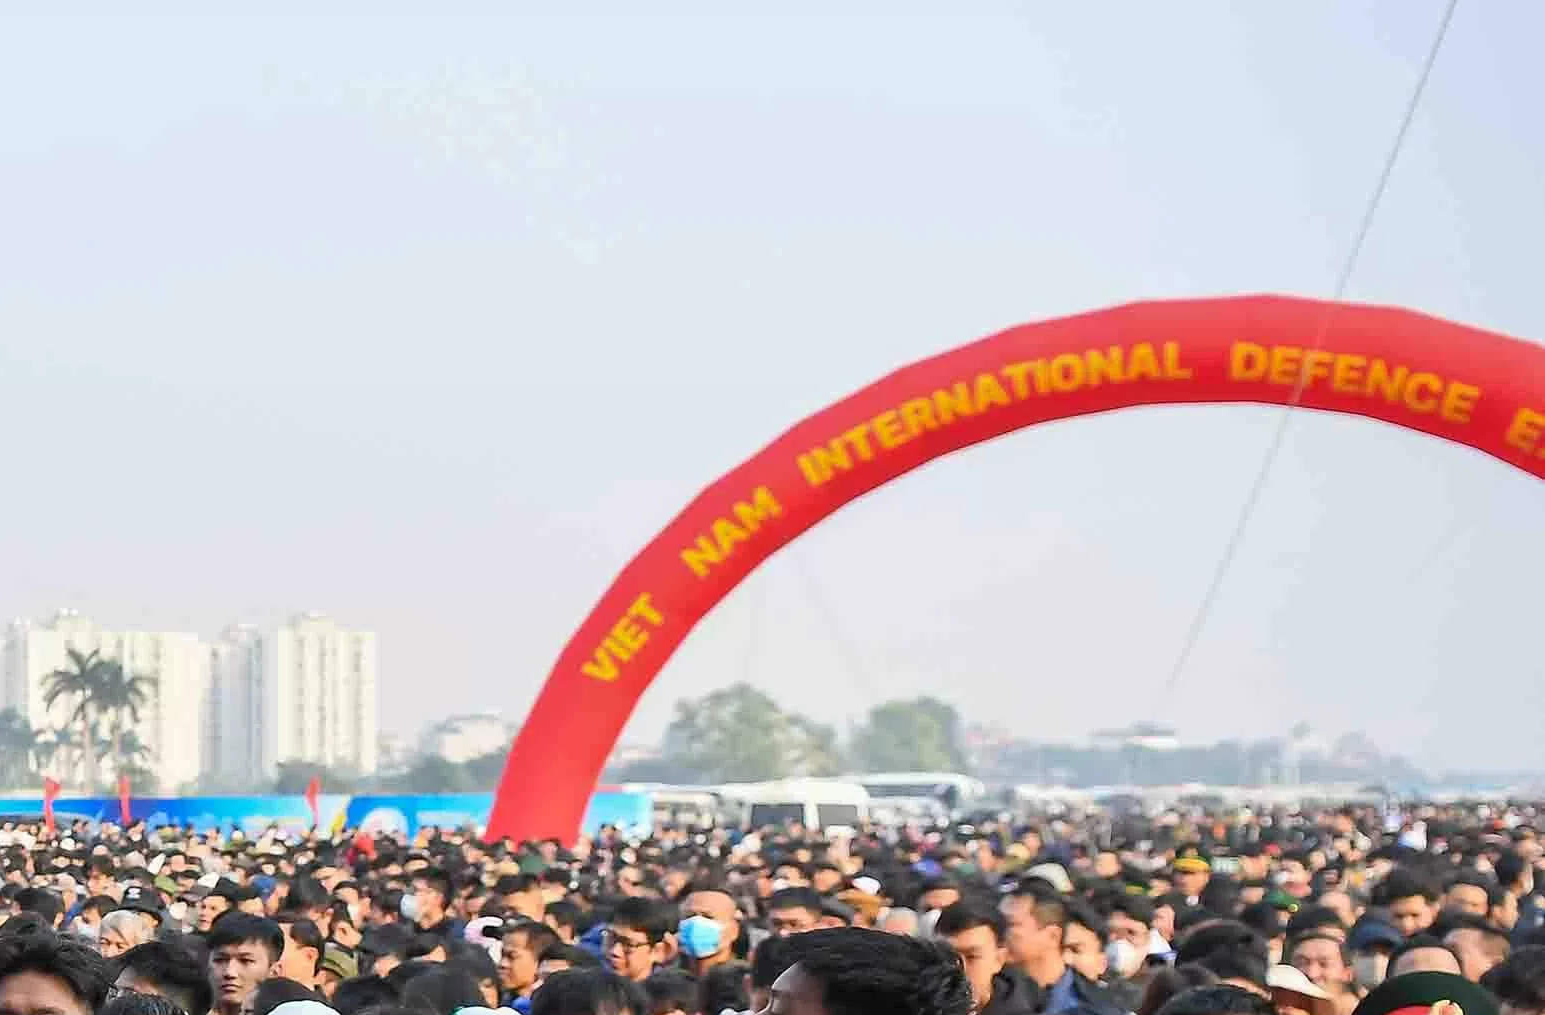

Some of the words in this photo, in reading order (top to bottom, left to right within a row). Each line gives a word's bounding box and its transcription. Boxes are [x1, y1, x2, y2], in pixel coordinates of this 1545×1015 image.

[581, 592, 663, 681] VIET
[679, 485, 782, 578] NAM
[796, 341, 1192, 487] INTERNATIONAL
[1229, 339, 1483, 424] DEFENCE
[1507, 406, 1545, 462] E
